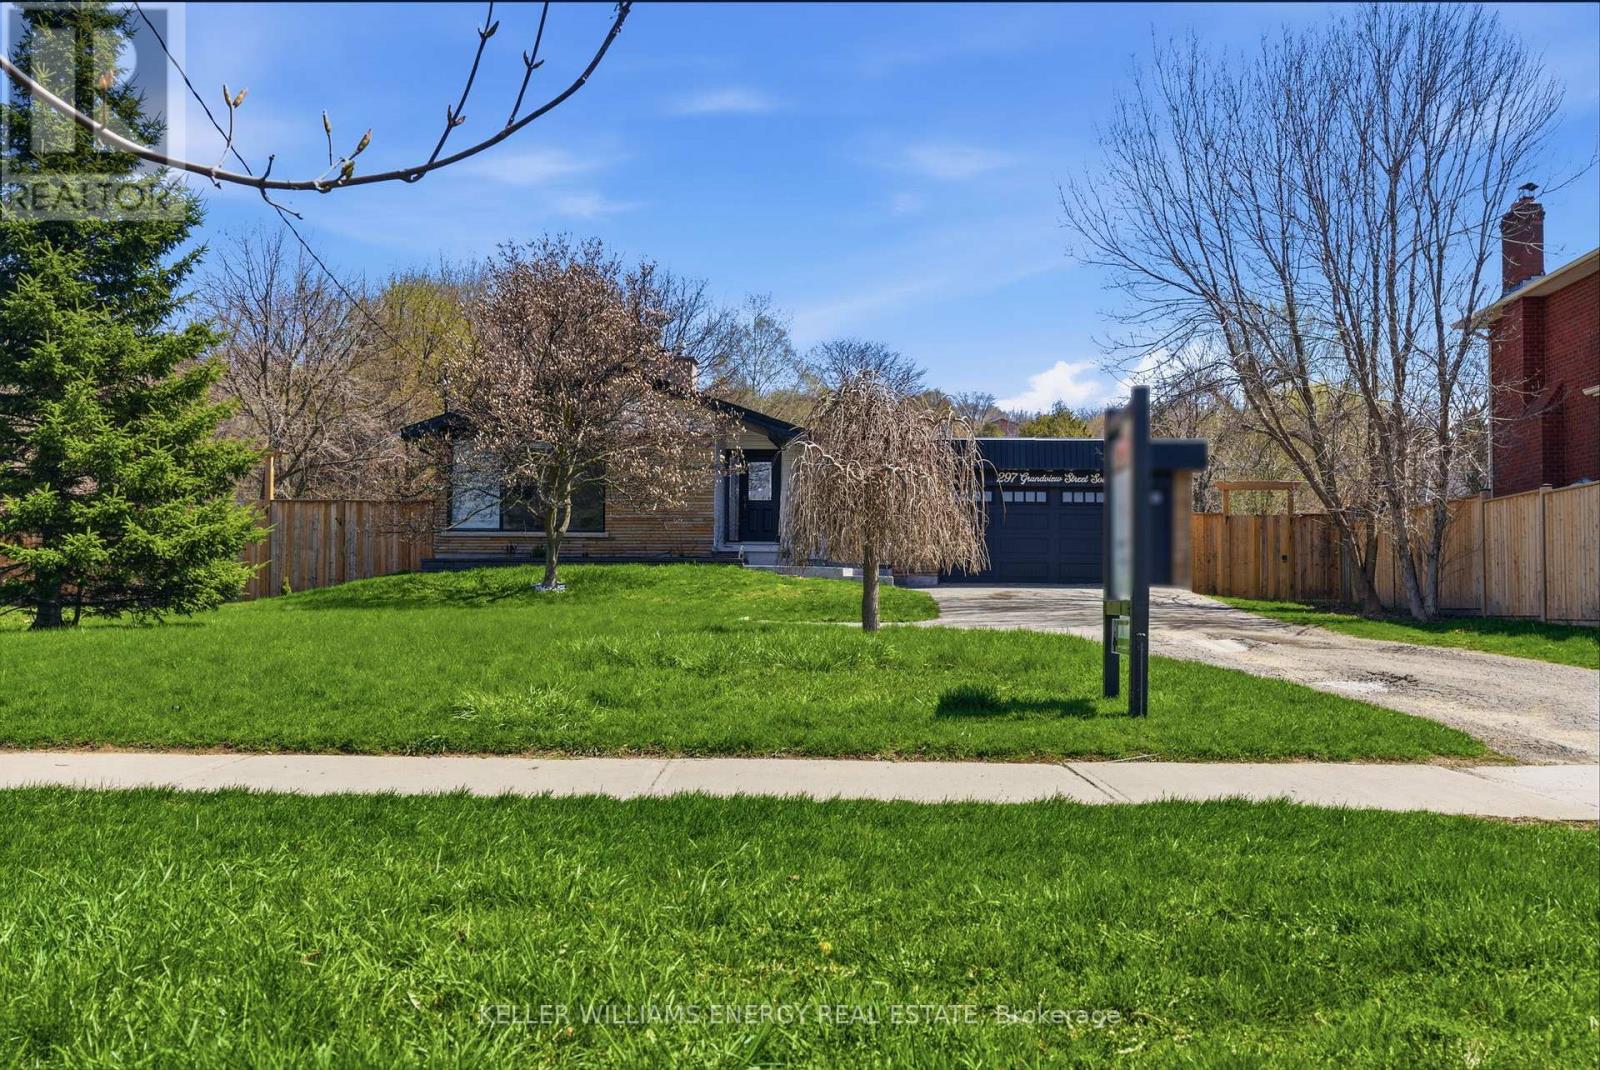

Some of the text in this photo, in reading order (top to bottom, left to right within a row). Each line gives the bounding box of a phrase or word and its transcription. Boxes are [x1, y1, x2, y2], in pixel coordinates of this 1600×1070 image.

[998, 472, 1018, 483] 297
[1020, 472, 1062, 485] Grandview
[1064, 472, 1089, 484] Street
